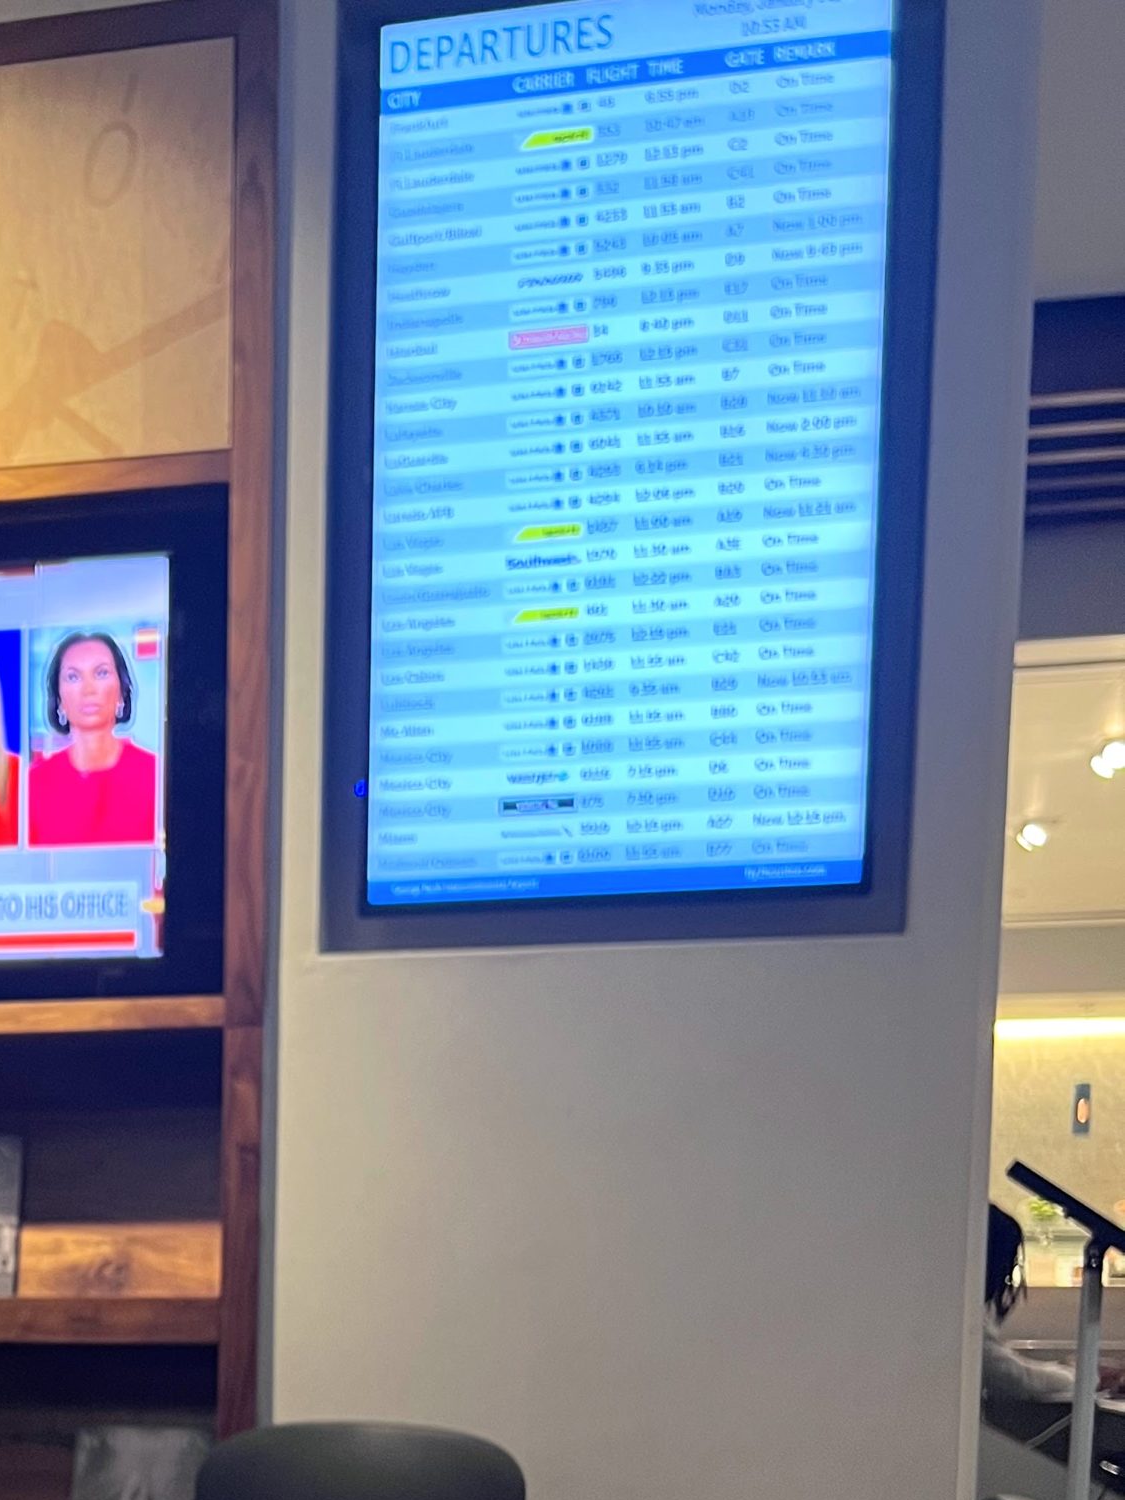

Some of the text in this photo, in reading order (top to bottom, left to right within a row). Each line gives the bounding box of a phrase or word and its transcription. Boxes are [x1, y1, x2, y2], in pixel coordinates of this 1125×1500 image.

[390, 14, 614, 74] DEPARTURES
[27, 893, 59, 920] HIS
[61, 890, 129, 918] OFFICE
